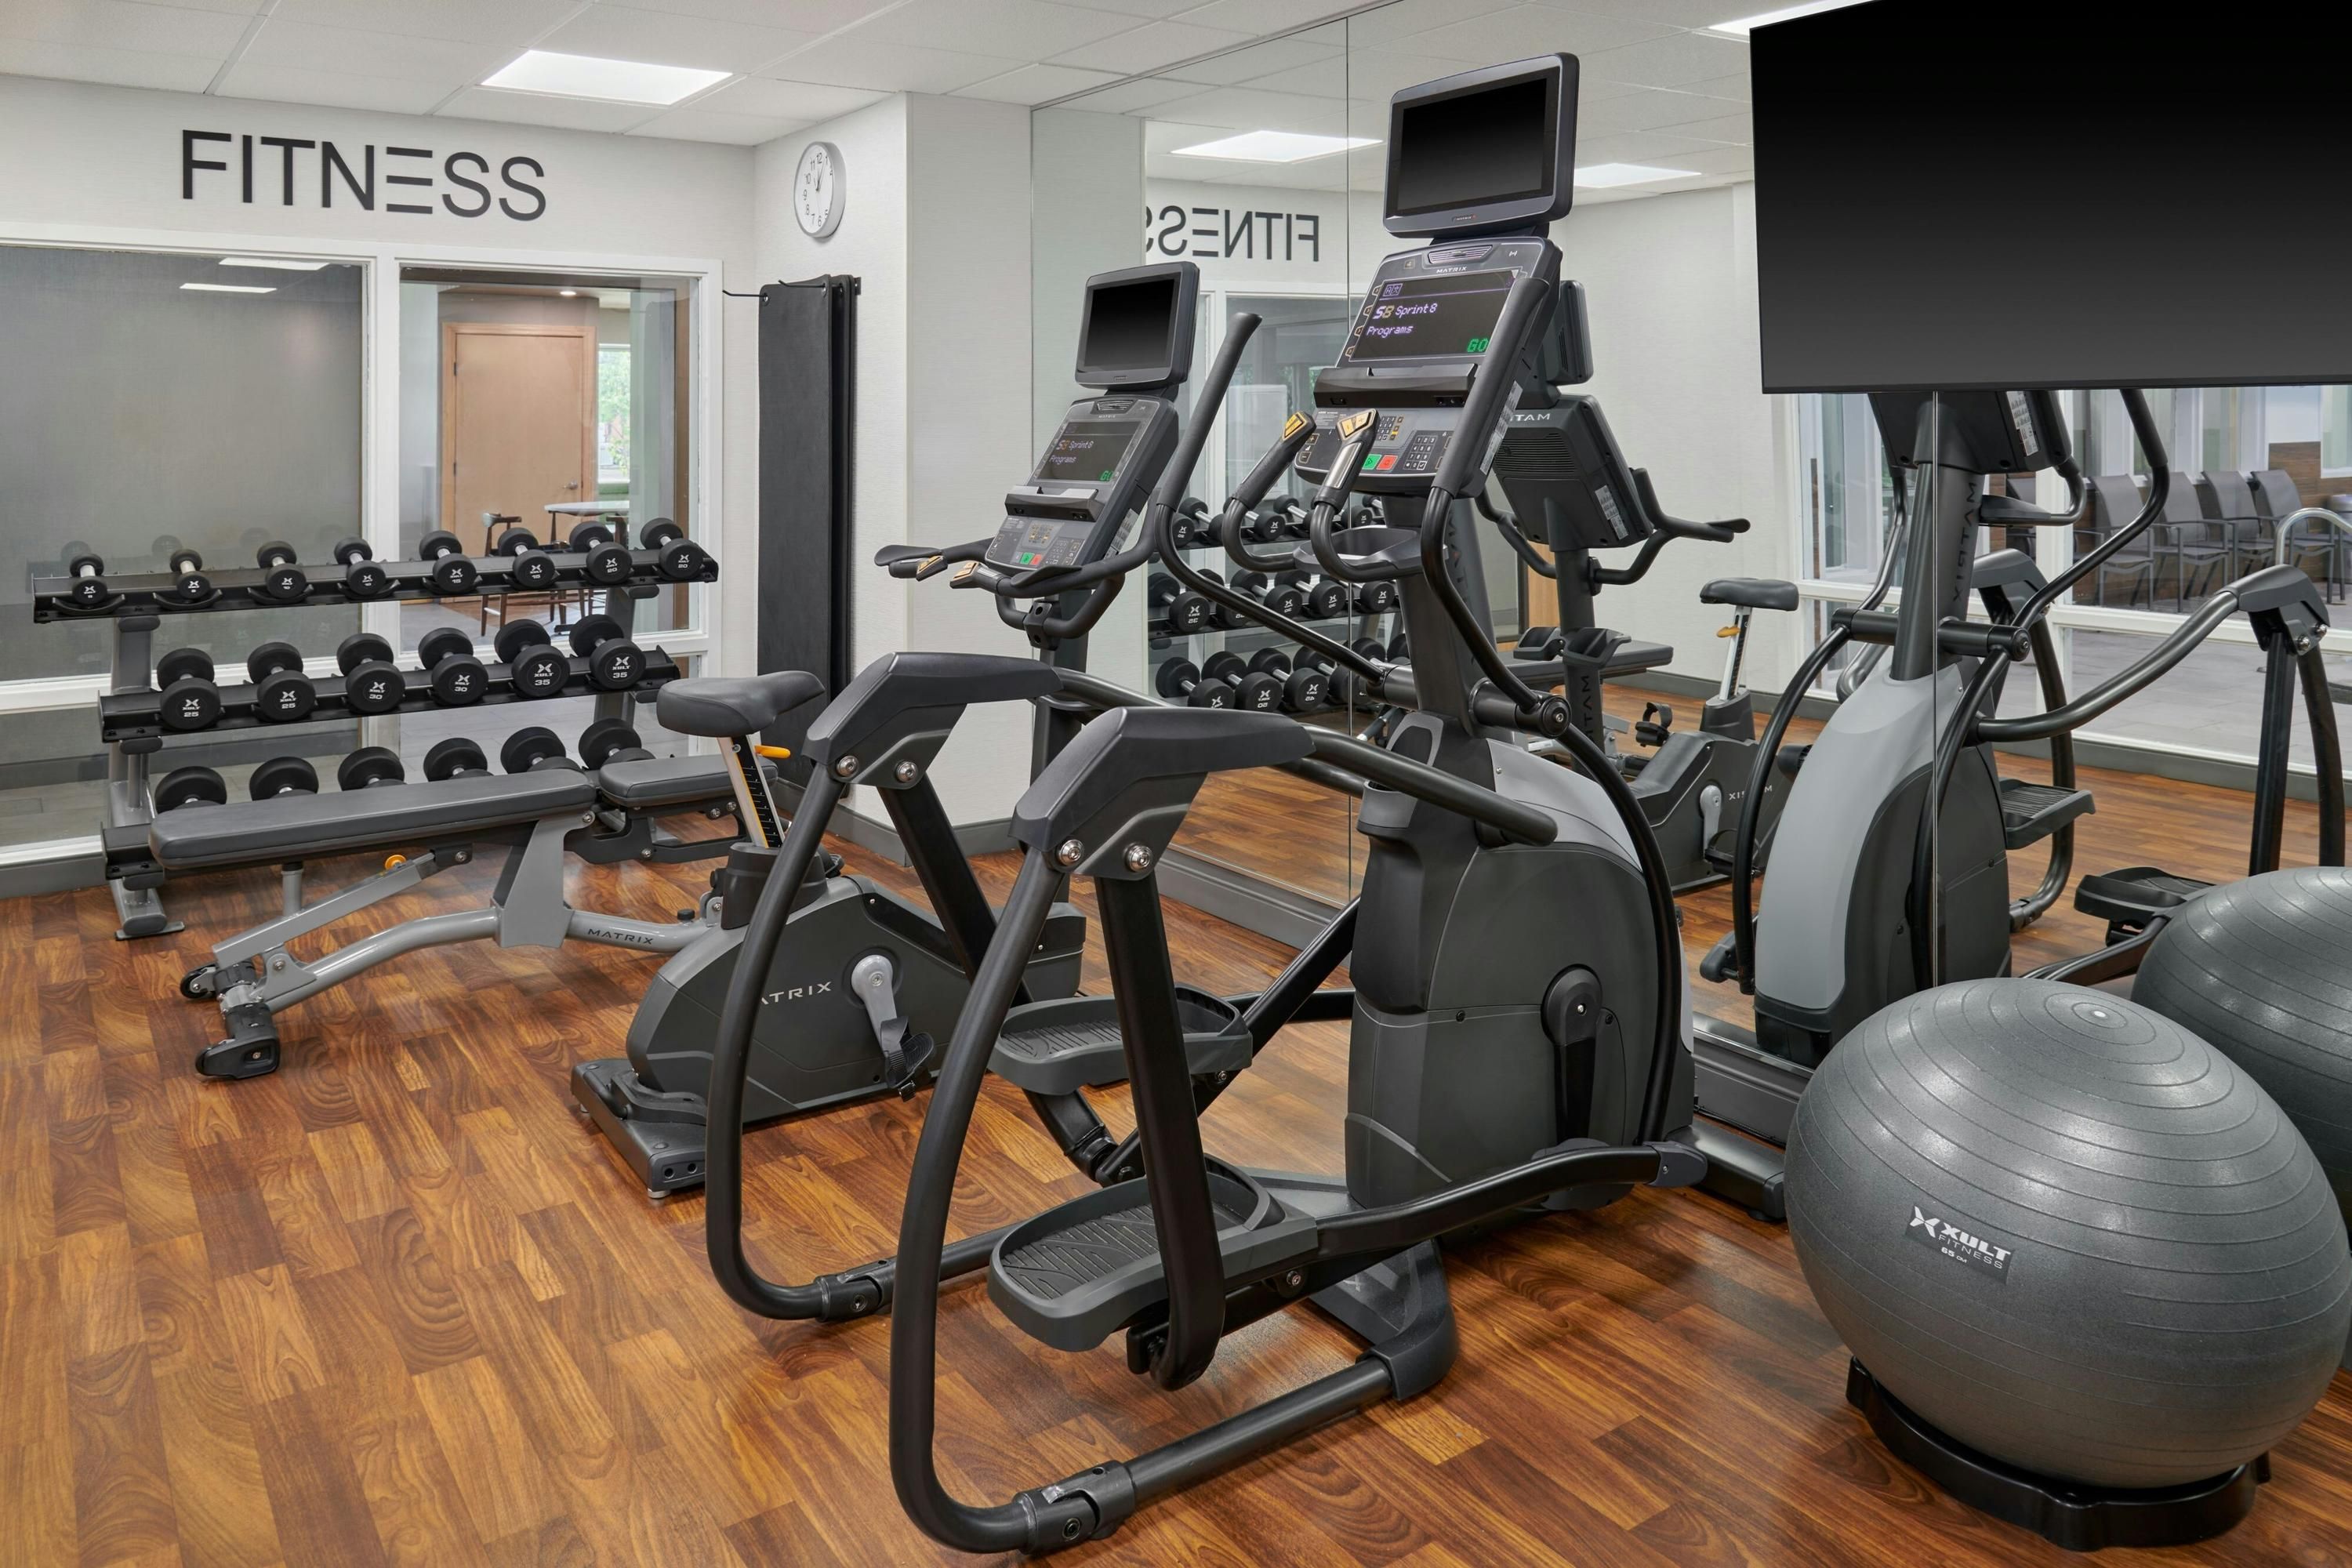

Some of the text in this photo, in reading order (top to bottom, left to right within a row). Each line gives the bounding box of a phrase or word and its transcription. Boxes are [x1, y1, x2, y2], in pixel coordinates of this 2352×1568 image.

[816, 152, 822, 164] 12
[183, 129, 546, 221] FITNESS
[1395, 304, 1429, 318] Sprint
[1429, 303, 1438, 313] 8
[1367, 325, 1414, 339] Programs
[1467, 338, 1489, 353] GO
[587, 929, 654, 946] MATRIX
[760, 981, 832, 1005] TRIX
[1941, 1222, 2012, 1261] XULT
[1938, 1234, 2003, 1269] FITNESS
[1941, 1247, 1955, 1258] 65
